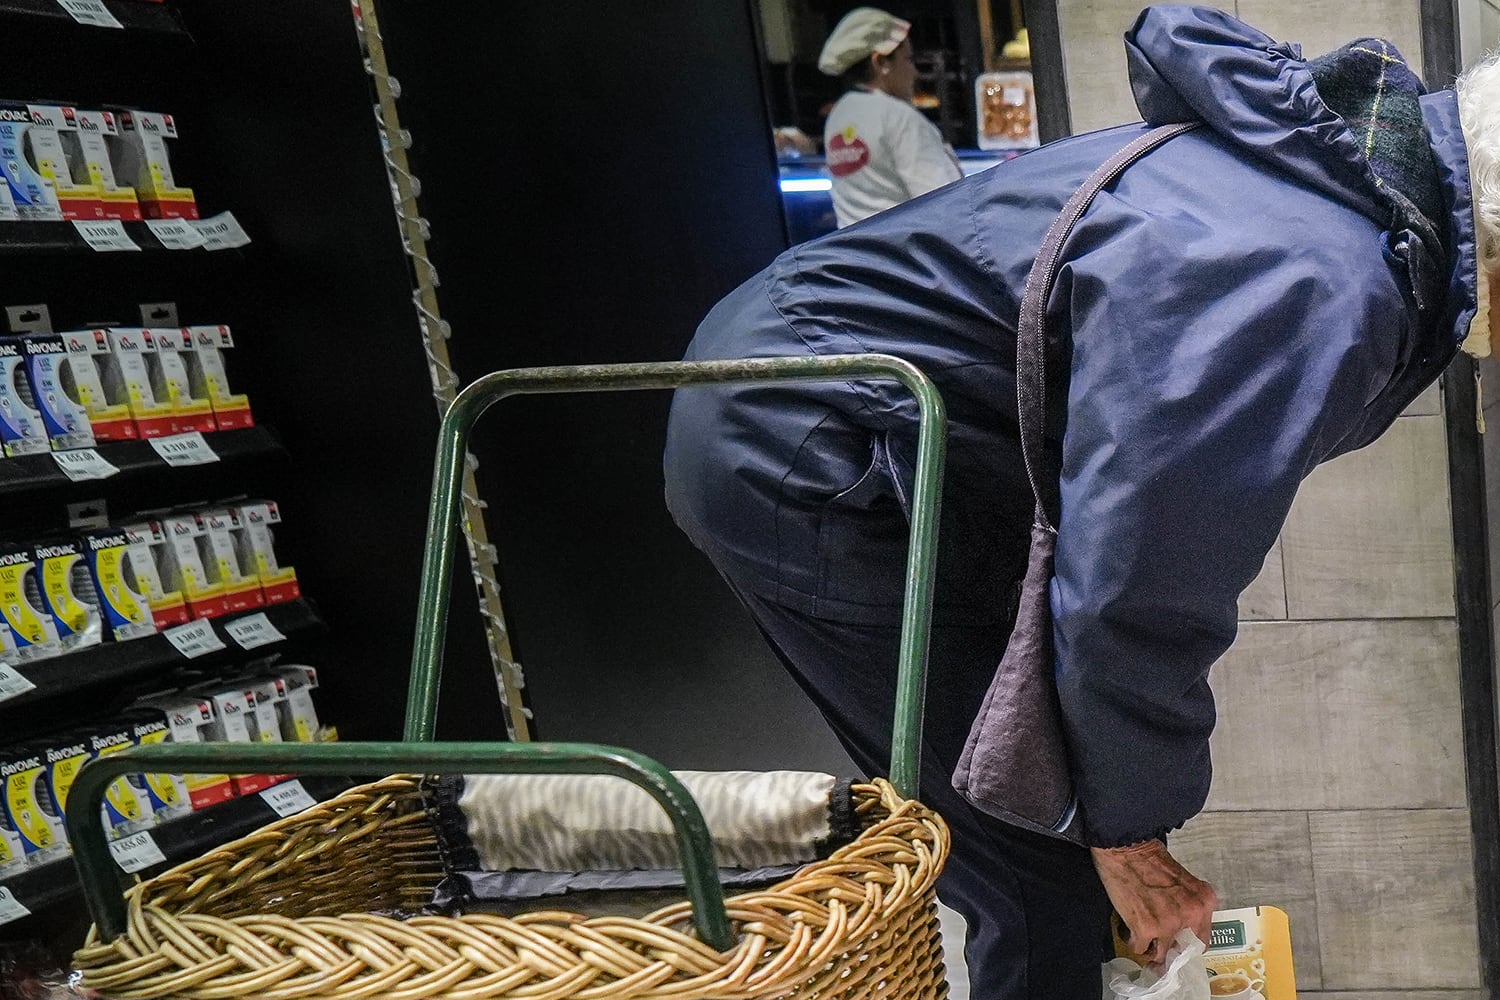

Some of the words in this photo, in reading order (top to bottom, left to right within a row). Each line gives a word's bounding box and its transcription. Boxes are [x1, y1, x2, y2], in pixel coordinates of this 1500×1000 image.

[0, 110, 28, 122] YOVAC
[26, 342, 64, 355] RAYOVAC
[89, 534, 126, 550] RAYOVAC
[0, 552, 29, 566] YOVAC
[36, 543, 76, 560] RAYOVAC
[92, 732, 129, 750] RAYOVAC
[47, 744, 86, 763] RAYOVAC
[1, 757, 41, 777] RAYOVAC
[1211, 928, 1236, 937] reen
[1206, 955, 1250, 963] ANZANILLA
